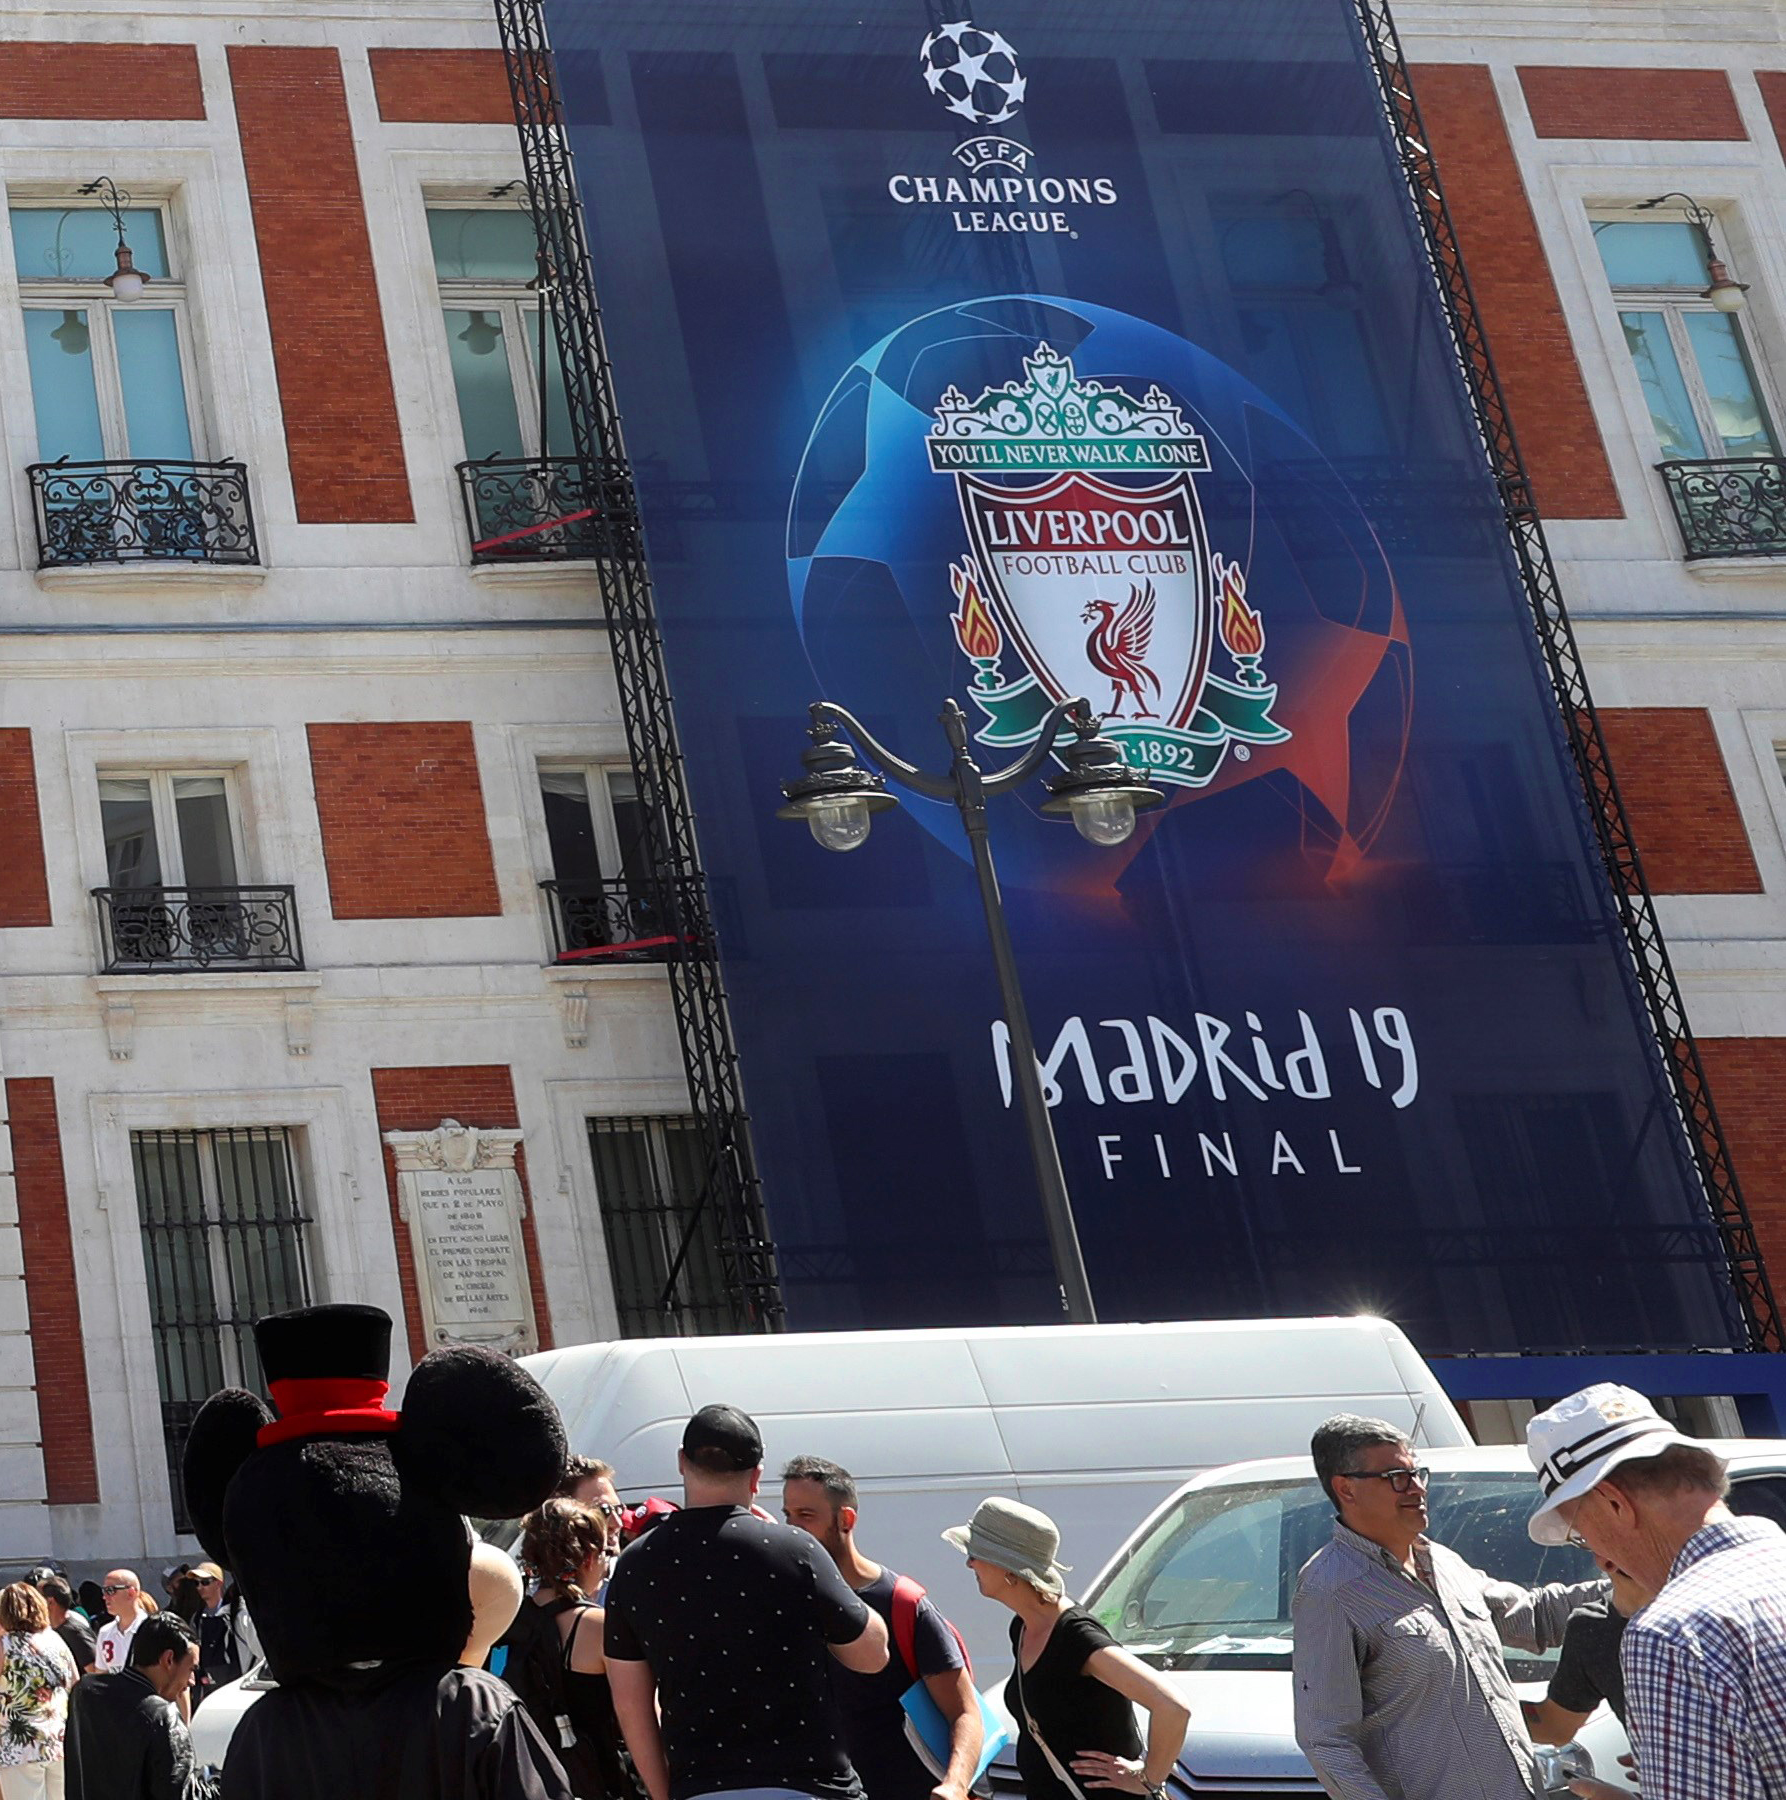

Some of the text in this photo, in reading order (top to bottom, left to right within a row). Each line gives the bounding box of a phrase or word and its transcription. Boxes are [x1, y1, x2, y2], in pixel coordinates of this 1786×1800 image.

[957, 142, 1027, 169] UEFA
[888, 175, 1118, 205] CHAMPIONS
[952, 211, 1070, 233] LEAGUE
[935, 442, 1201, 465] YOU'LL NEVER WALK ALONE
[984, 509, 1190, 547] LIVERPOOL
[1002, 553, 1188, 577] FOOTBALL CLUB
[1348, 1006, 1419, 1109] 19
[1097, 1129, 1362, 1180] FINAL
[476, 1199, 504, 1208] MAYO
